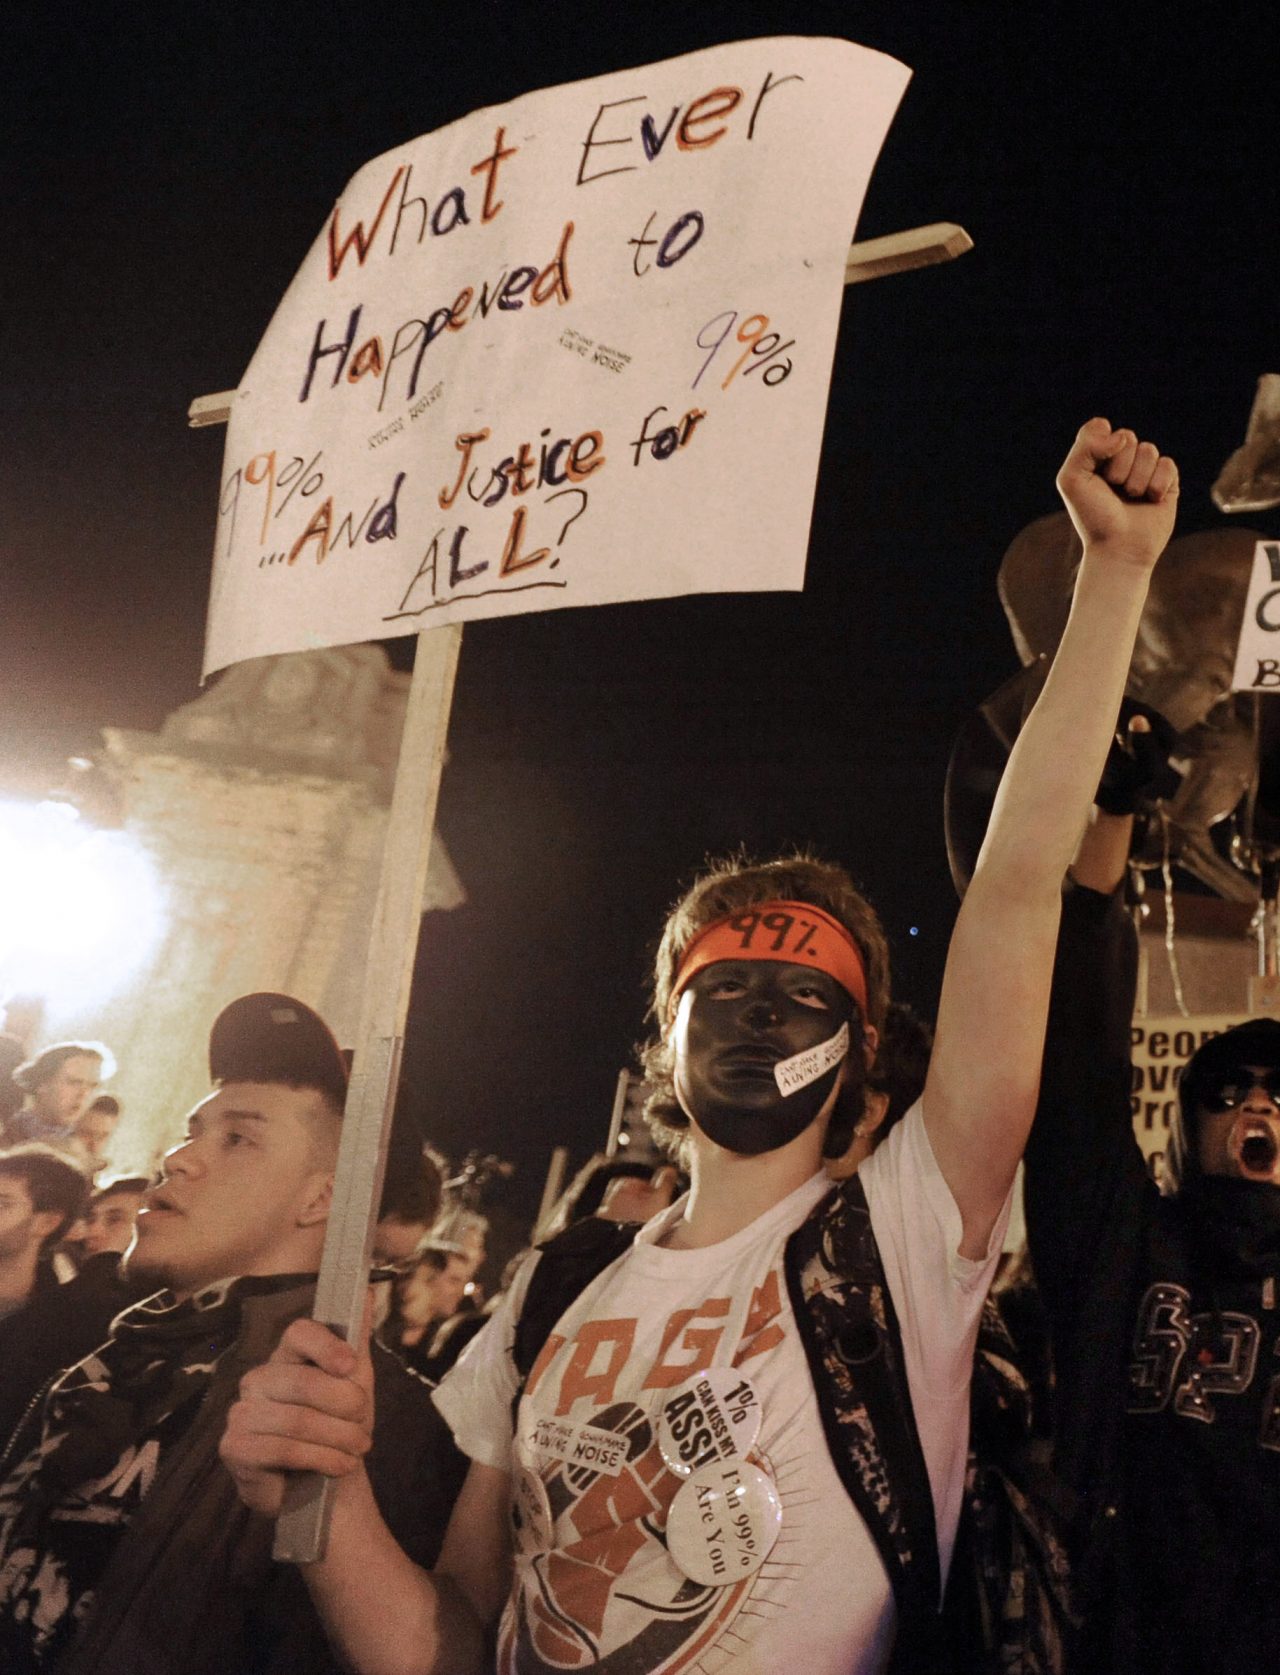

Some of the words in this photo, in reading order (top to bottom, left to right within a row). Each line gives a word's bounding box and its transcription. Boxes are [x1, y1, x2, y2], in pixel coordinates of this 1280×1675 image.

[328, 126, 517, 280] What
[576, 72, 804, 186] Ever
[692, 310, 796, 391] 99%
[438, 427, 606, 509] Justice
[630, 406, 707, 466] for
[218, 450, 324, 558] 99%
[400, 488, 588, 611] ALL?
[730, 912, 818, 956] 99%
[665, 1390, 719, 1473] ASS!
[696, 1380, 716, 1408] CAN
[706, 1405, 728, 1438] KISS
[718, 1435, 738, 1458] MY
[723, 1381, 758, 1424] 1%
[573, 1443, 620, 1467] NOISE
[695, 1485, 715, 1523] Are
[706, 1528, 726, 1575] You
[731, 1514, 759, 1566] 99%
